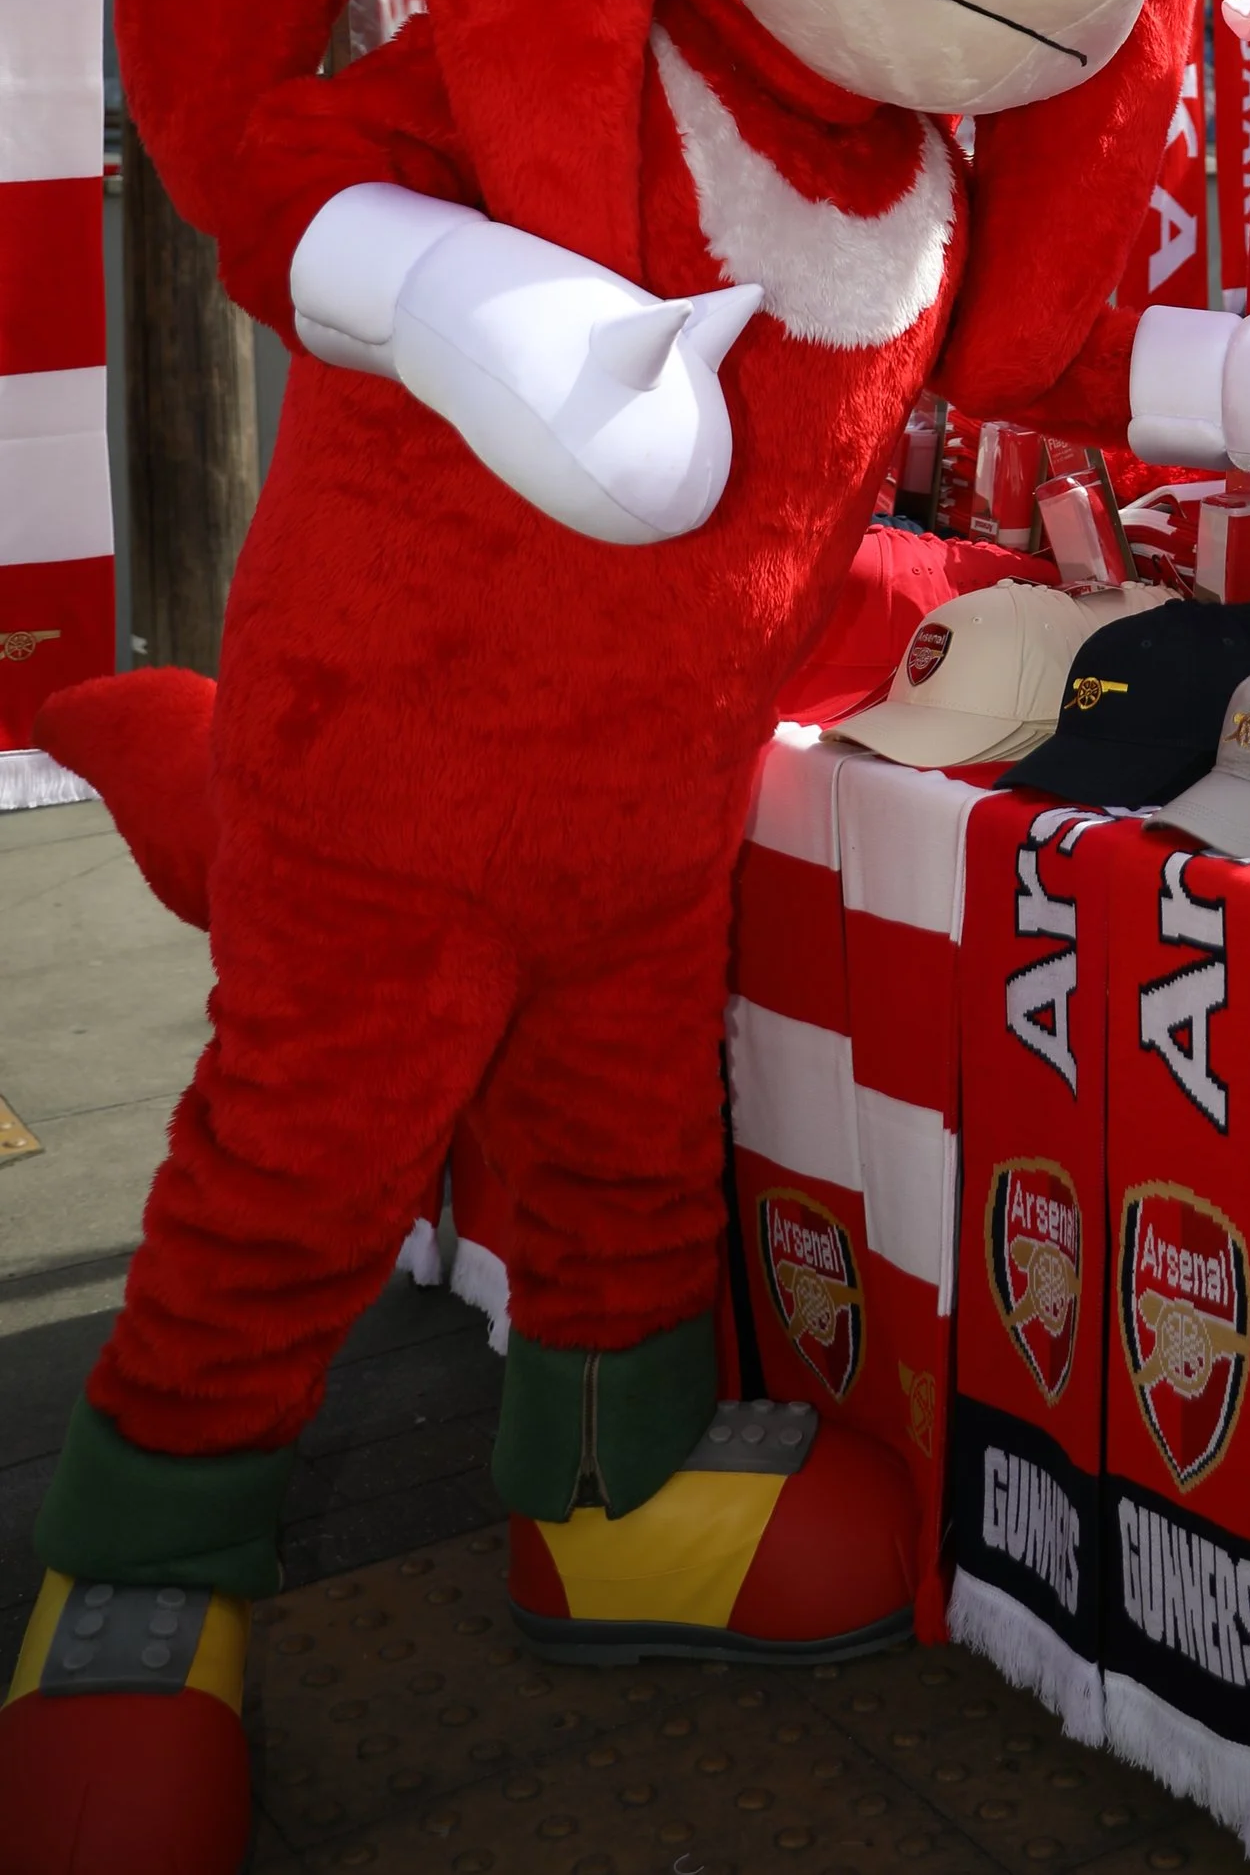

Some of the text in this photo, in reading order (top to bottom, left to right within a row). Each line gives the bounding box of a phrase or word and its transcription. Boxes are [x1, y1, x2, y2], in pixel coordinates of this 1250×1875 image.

[918, 630, 946, 646] Arsenal
[773, 1207, 840, 1273] Arsenal
[1011, 1179, 1080, 1256] Arsenal
[1141, 1223, 1230, 1307] Arsenal
